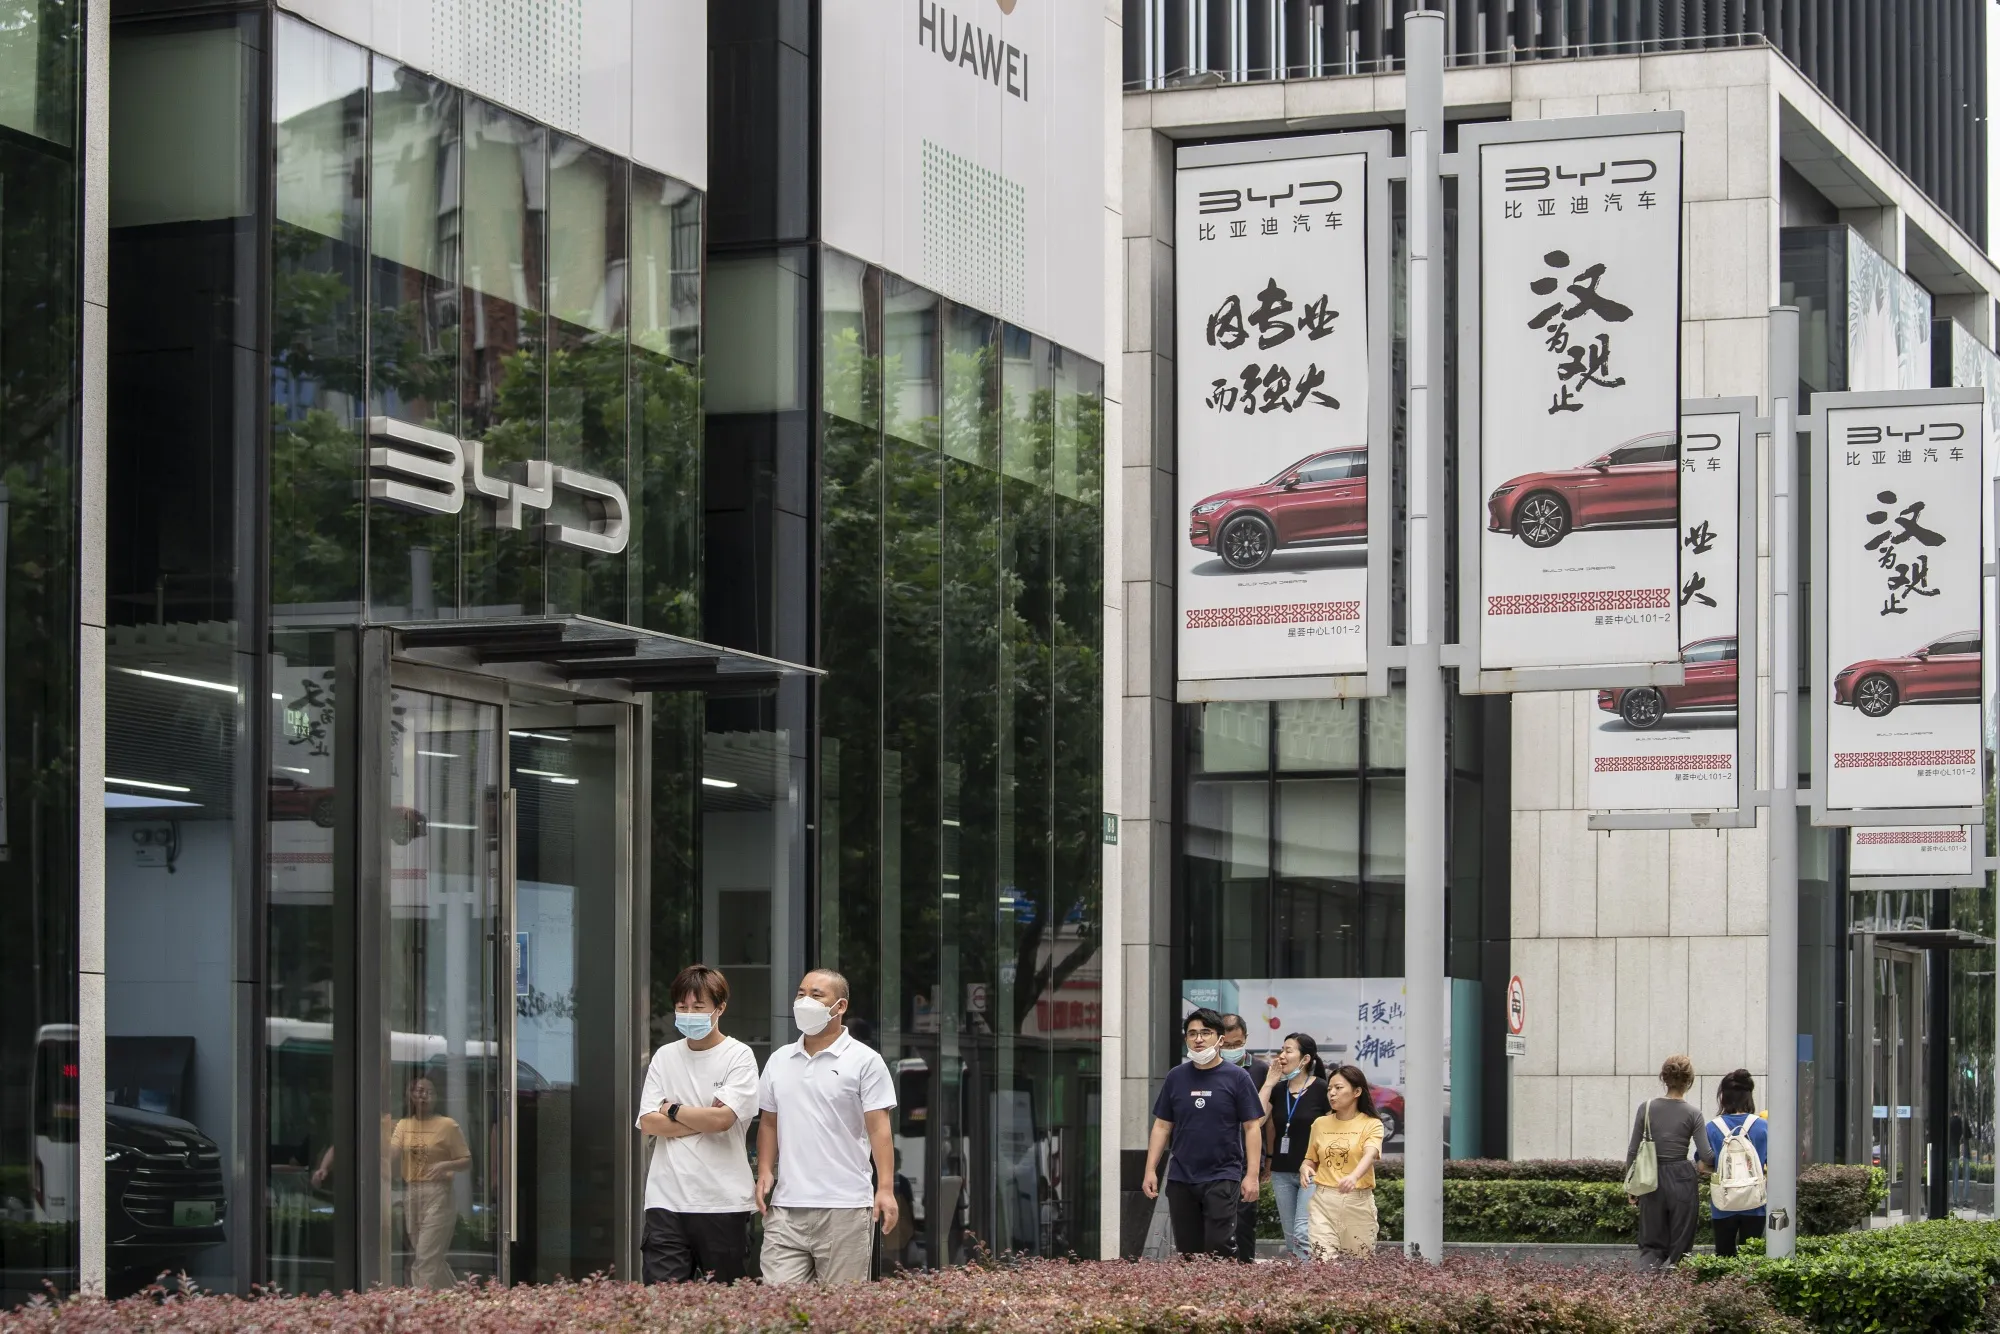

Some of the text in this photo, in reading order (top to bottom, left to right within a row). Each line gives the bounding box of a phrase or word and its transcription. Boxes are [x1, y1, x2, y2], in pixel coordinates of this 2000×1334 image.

[918, 0, 1028, 102] HUAWEI
[1505, 159, 1657, 192] BYD
[1199, 180, 1343, 214] BYD
[1504, 190, 1657, 219] 比亚迪汽车
[1199, 211, 1343, 241] 比亚迪汽车
[1846, 422, 1965, 445] BYD
[1846, 446, 1965, 466] 比亚迪汽车
[369, 415, 630, 554] BYD
[1358, 999, 1405, 1024] 百变出
